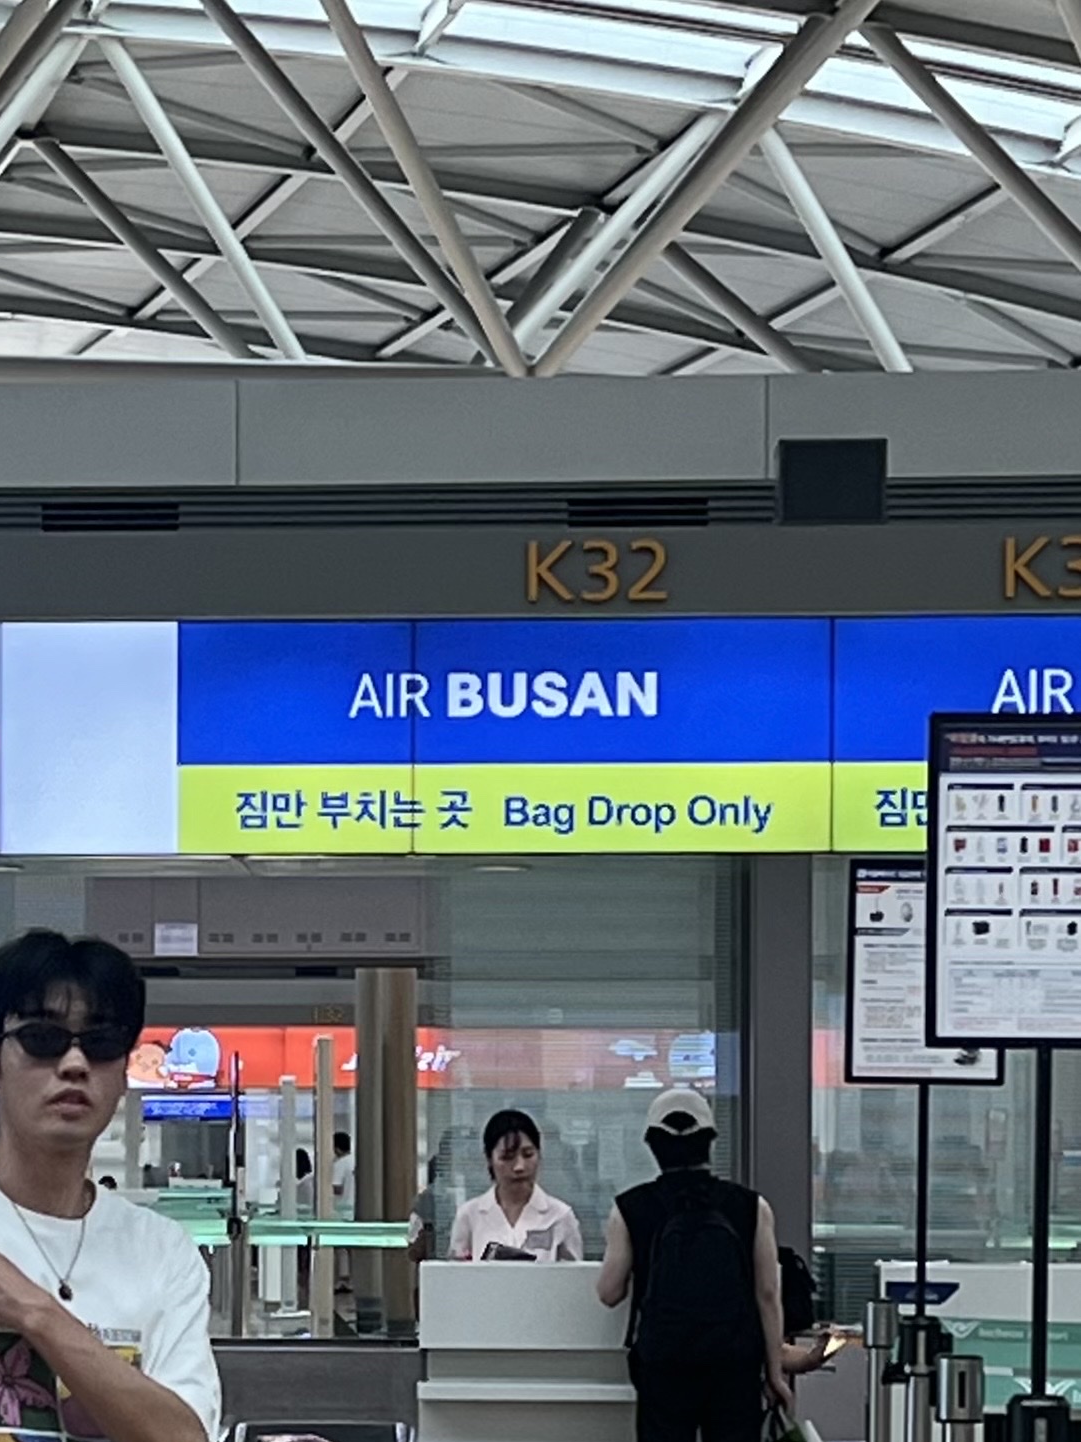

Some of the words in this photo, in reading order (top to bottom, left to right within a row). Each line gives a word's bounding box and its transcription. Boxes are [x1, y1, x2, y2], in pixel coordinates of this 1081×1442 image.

[526, 537, 669, 603] K32
[348, 673, 430, 719] AIR
[447, 671, 658, 718] BUSAN
[991, 668, 1075, 714] AIR
[235, 791, 307, 830] 짐만
[317, 791, 425, 830] 부치는
[436, 790, 473, 829] 곳
[503, 795, 575, 833] Bag
[587, 796, 676, 833] Drop
[687, 794, 773, 833] Only
